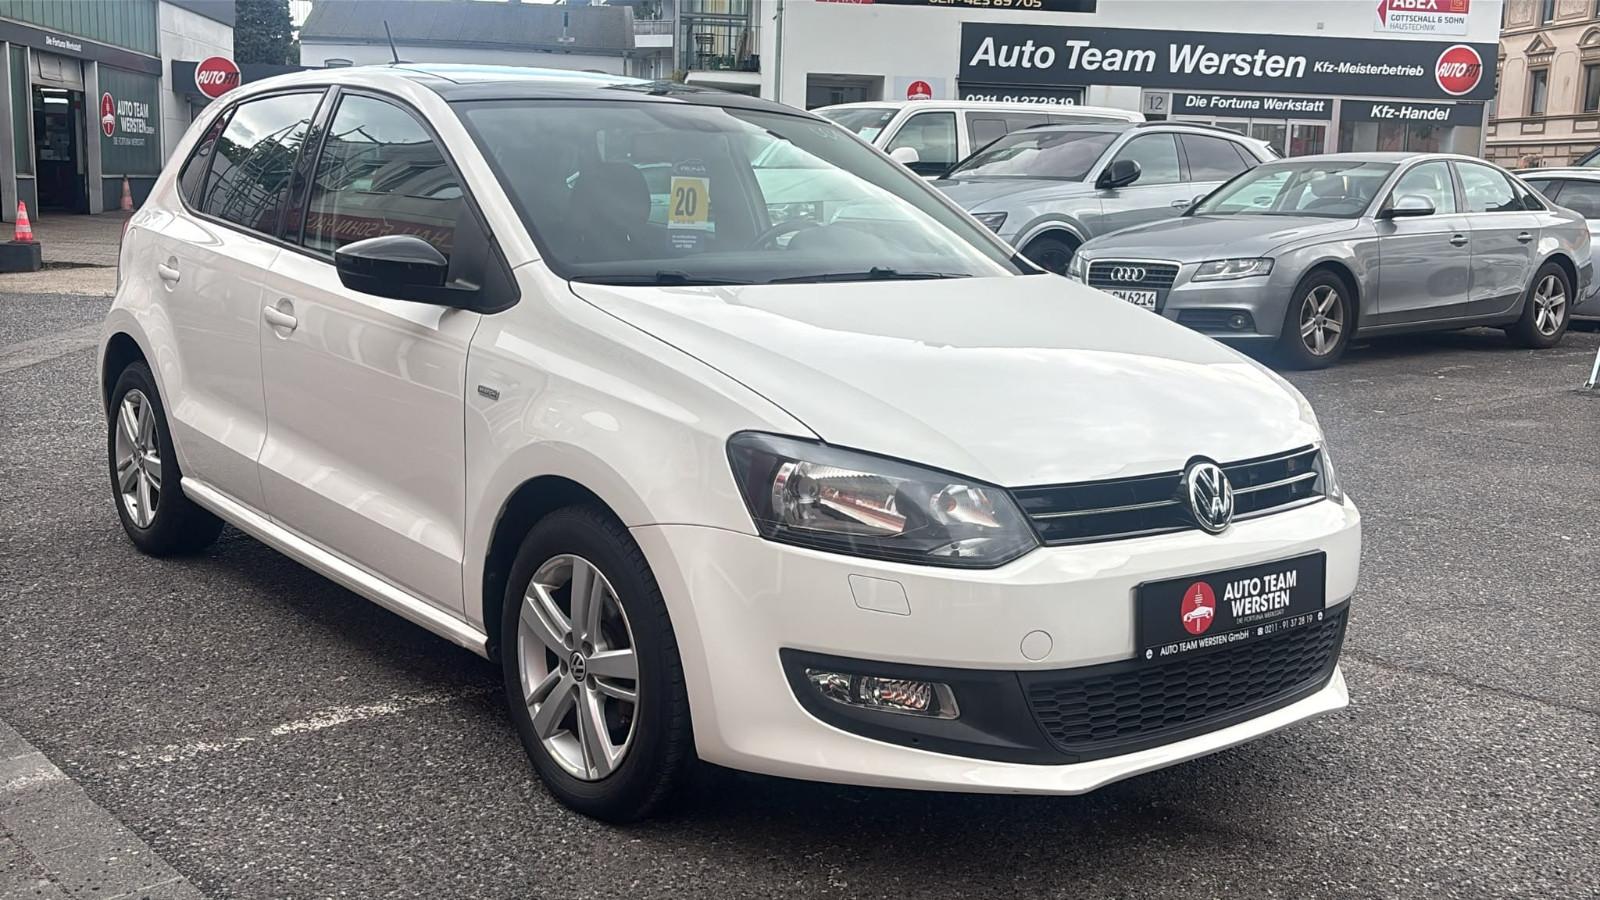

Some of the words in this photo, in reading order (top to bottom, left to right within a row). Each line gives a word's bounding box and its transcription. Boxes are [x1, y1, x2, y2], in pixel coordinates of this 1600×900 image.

[1391, 0, 1438, 9] ABEX
[1390, 14, 1436, 23] GOTTSCHALL
[1390, 23, 1435, 31] HAUSTECHNIK
[969, 37, 1055, 69] Auto
[1065, 40, 1156, 72] Team
[1168, 44, 1307, 77] Wersten
[1314, 60, 1424, 77] Kfz-Meisterbetrieb
[117, 100, 133, 116] AUTO
[133, 102, 149, 118] TEAM
[1149, 96, 1163, 111] 12
[1185, 95, 1207, 107] Die
[1209, 96, 1260, 110] Fortuna
[1263, 98, 1325, 112] Werkstatt
[1370, 104, 1450, 121] Kfz-Handel
[121, 117, 147, 133] WERSTEN
[675, 187, 697, 217] 20
[1224, 578, 1261, 601] AUTO
[1263, 570, 1297, 591] TEAM
[1231, 590, 1290, 617] WERSTEN
[1160, 644, 1178, 656] AUTO
[1179, 640, 1198, 652] TEAM
[1198, 636, 1227, 648] WERSTEN
[1228, 631, 1249, 642] GmbH
[1264, 622, 1278, 634] 0211
[1282, 619, 1289, 630] 91
[1290, 616, 1297, 628] 37
[1298, 614, 1305, 626] 28
[1306, 613, 1313, 624] 19
